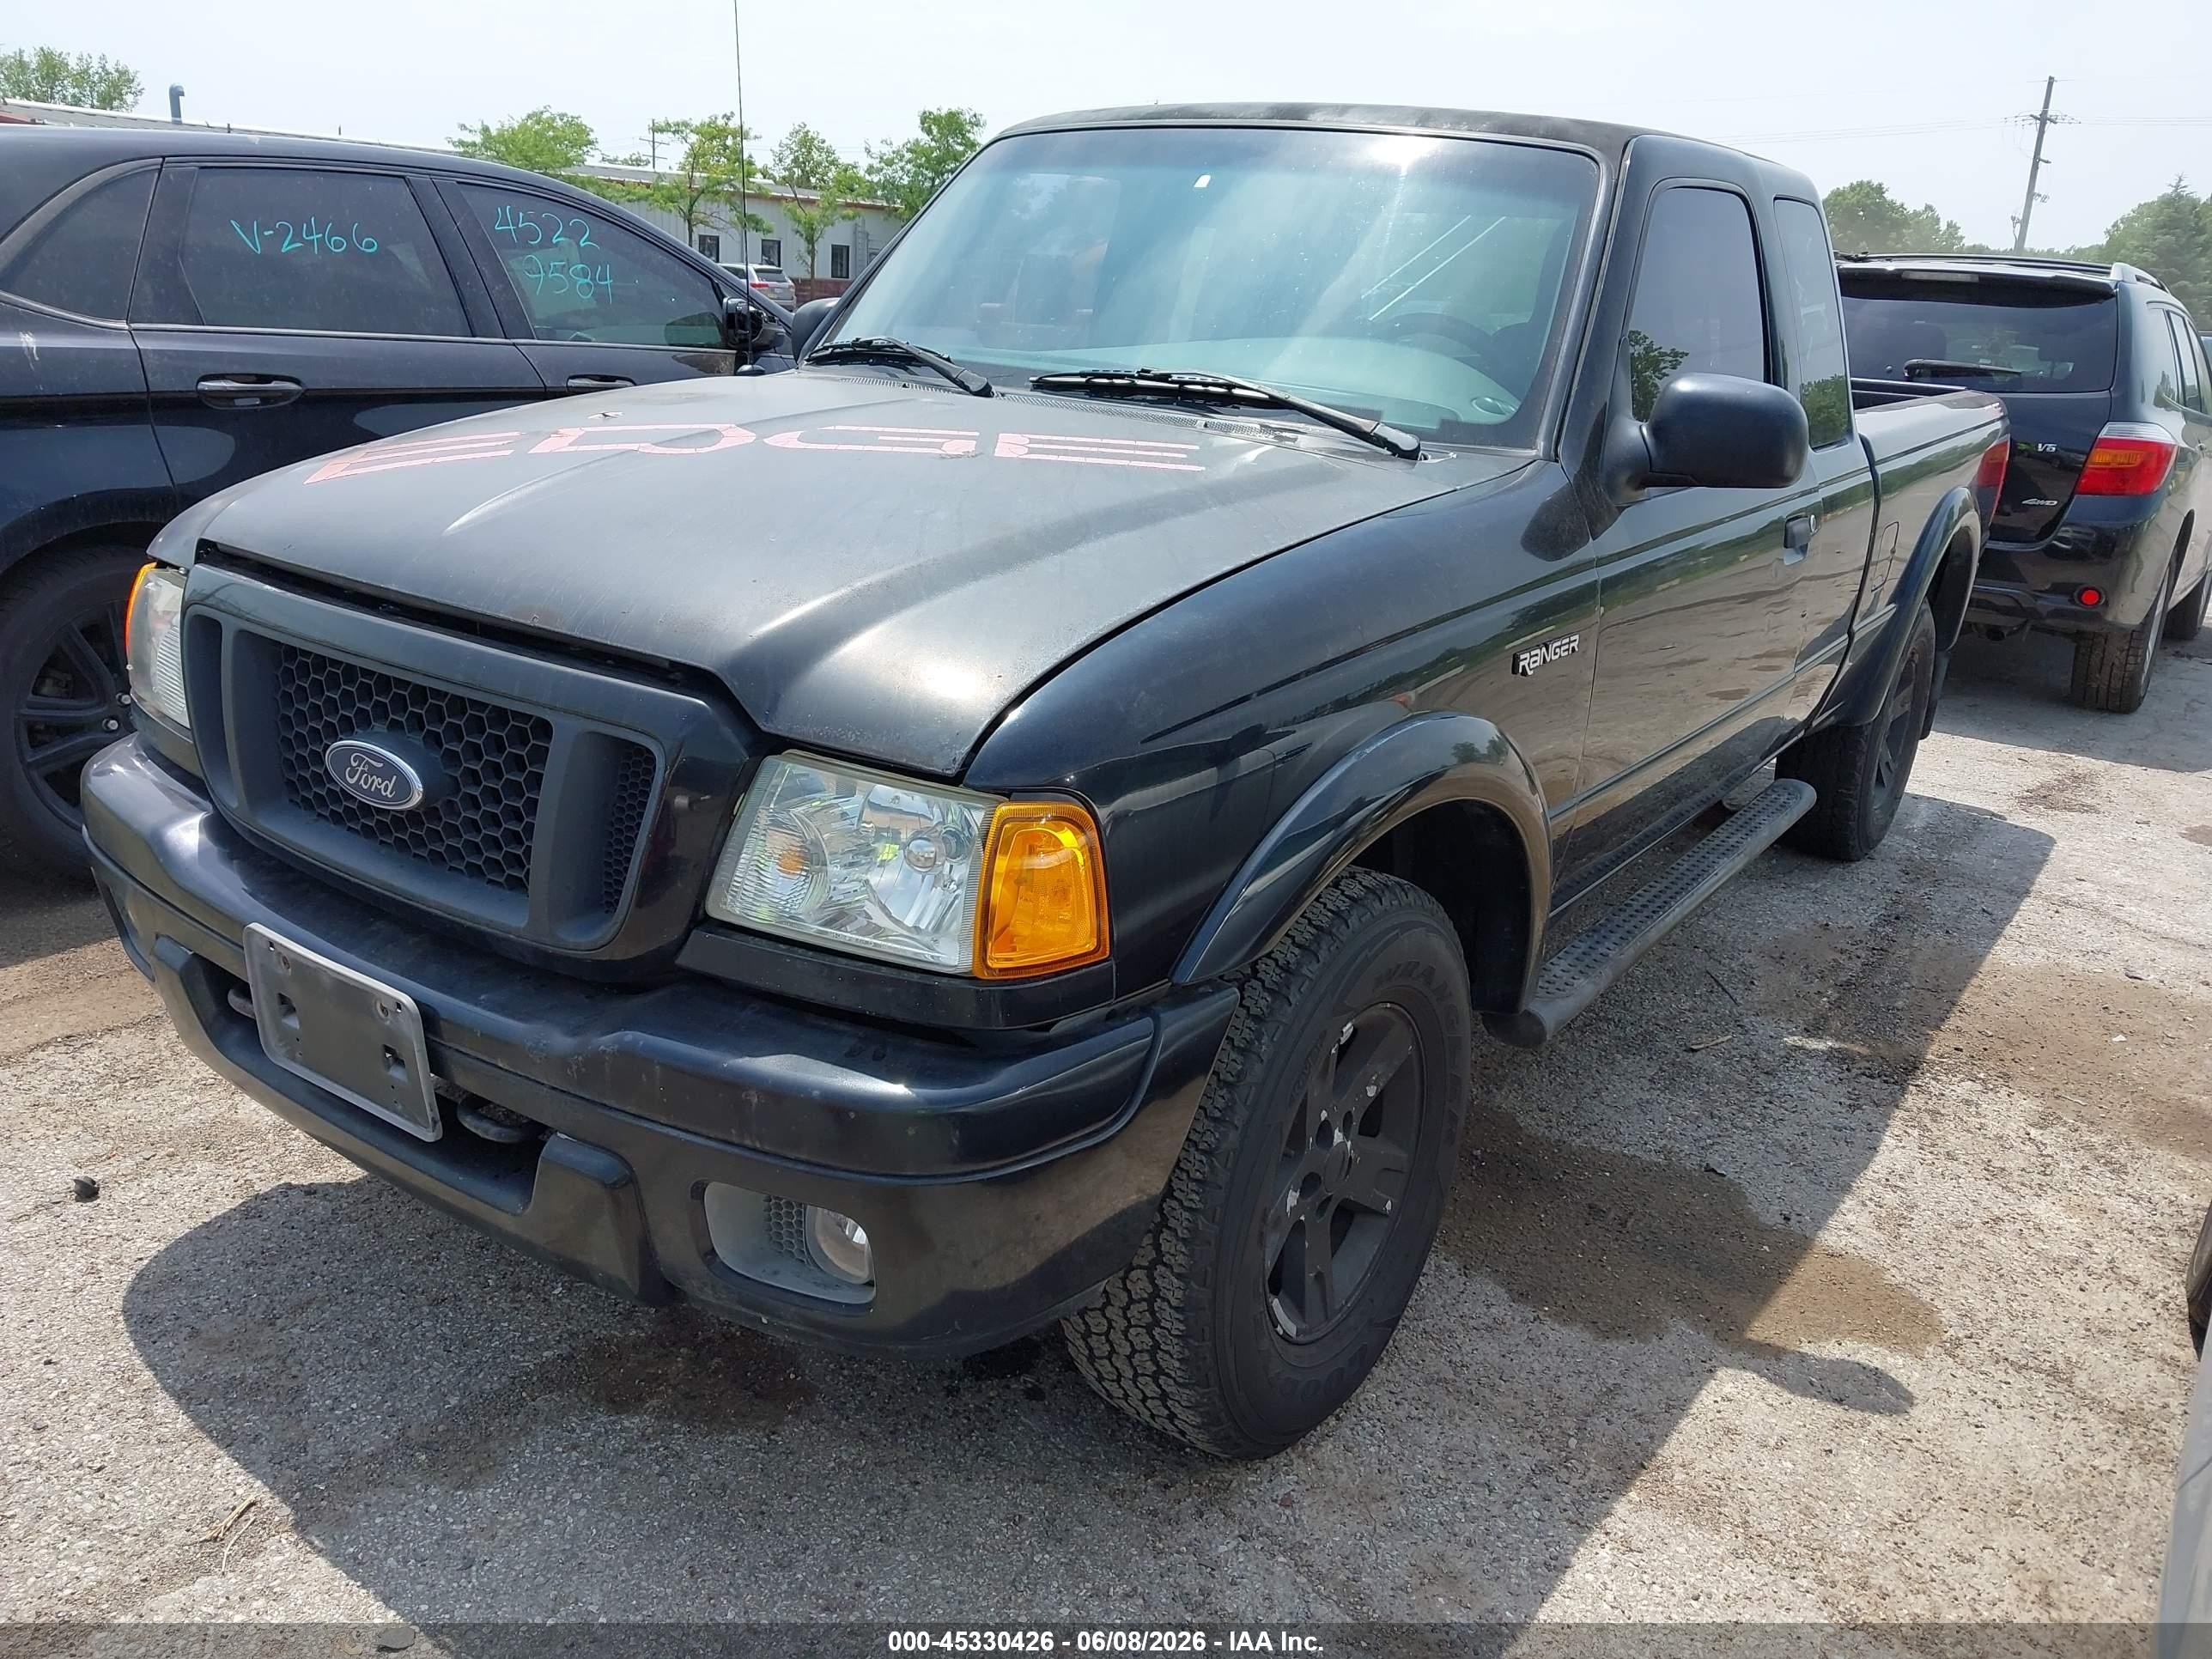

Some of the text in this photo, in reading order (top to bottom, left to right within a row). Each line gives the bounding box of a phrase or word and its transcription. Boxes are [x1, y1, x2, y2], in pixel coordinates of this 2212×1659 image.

[229, 216, 379, 255] V-2466
[494, 205, 601, 250] 4522
[522, 254, 614, 305] 9584
[302, 423, 1206, 485] EDGE
[2037, 442, 2058, 453] V6
[2021, 498, 2058, 507] 4WD
[1517, 634, 1580, 676] RANGER
[344, 752, 398, 799] Ford
